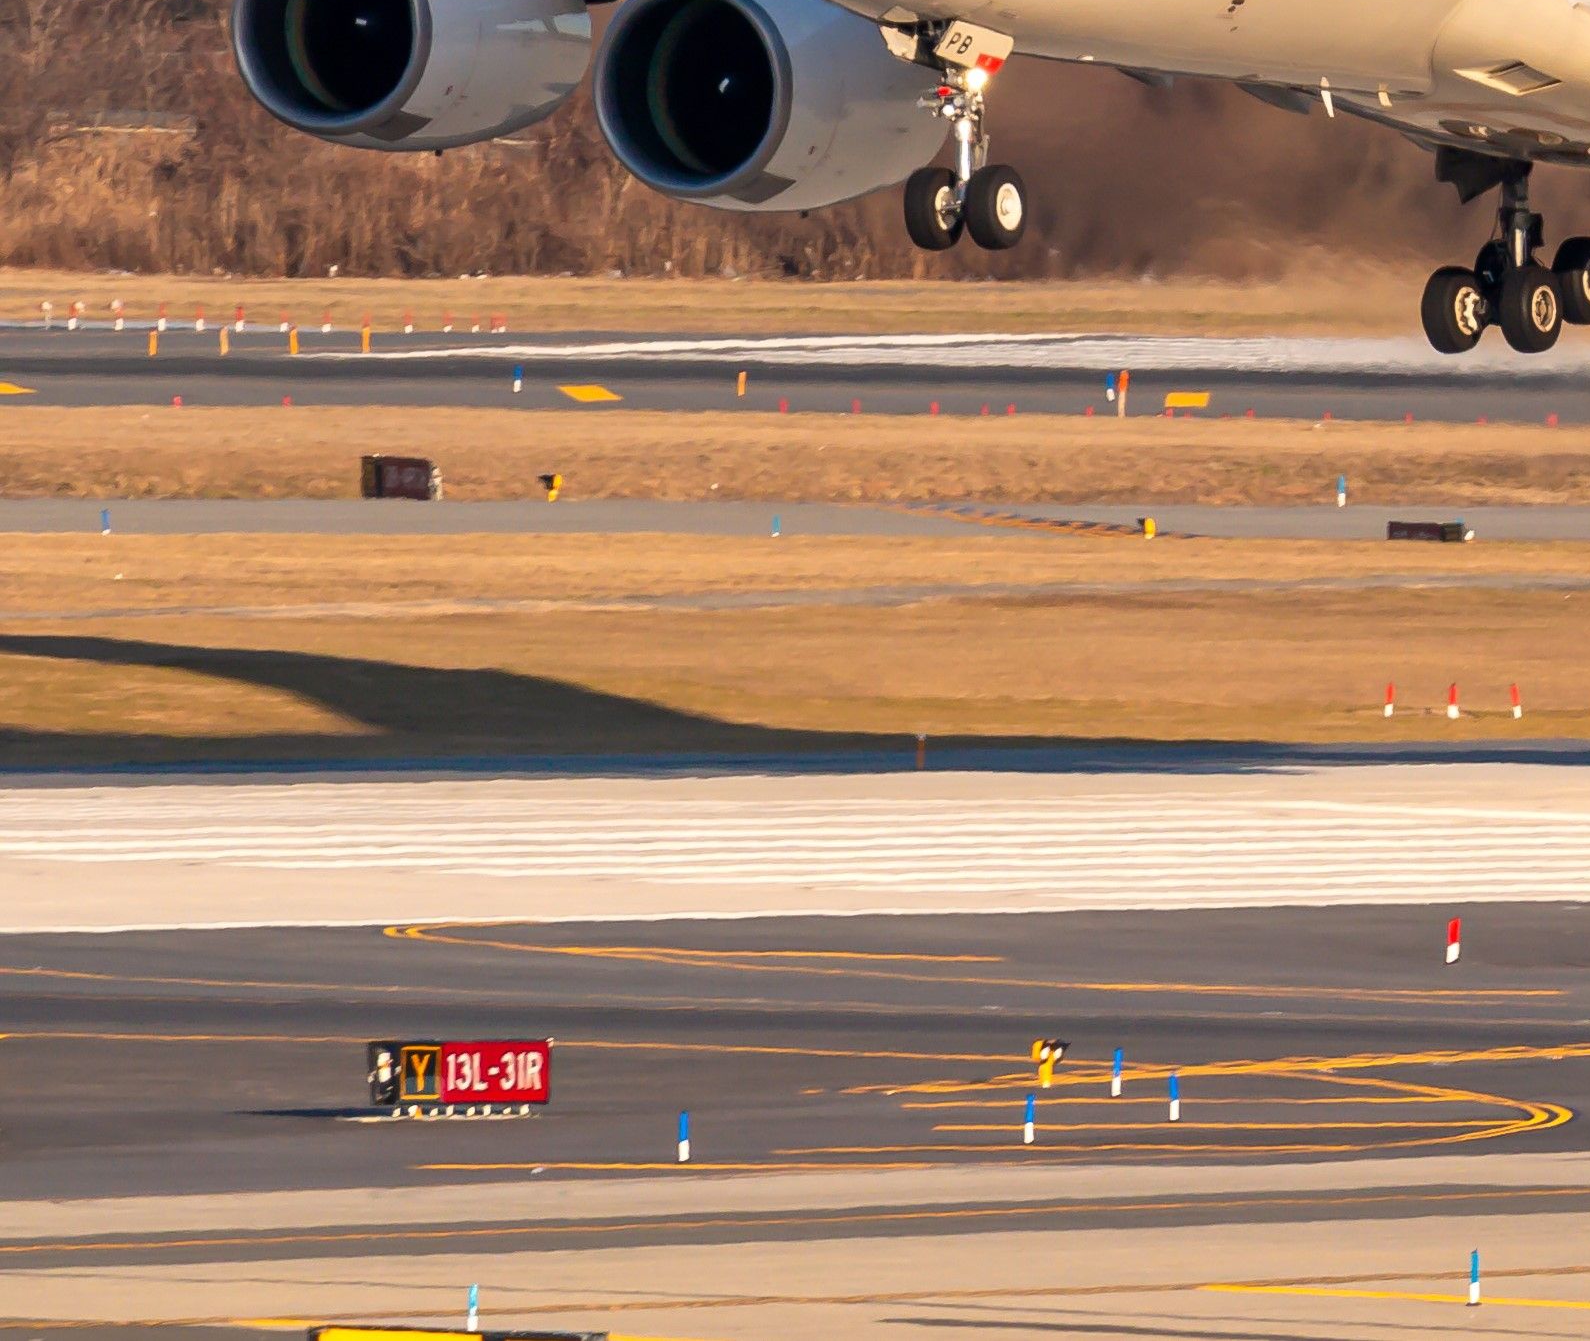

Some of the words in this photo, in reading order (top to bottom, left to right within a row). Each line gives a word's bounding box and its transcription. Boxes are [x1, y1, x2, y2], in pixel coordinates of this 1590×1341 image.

[945, 31, 973, 55] PB
[411, 1053, 430, 1093] Y
[446, 1051, 544, 1093] 13L-31R
